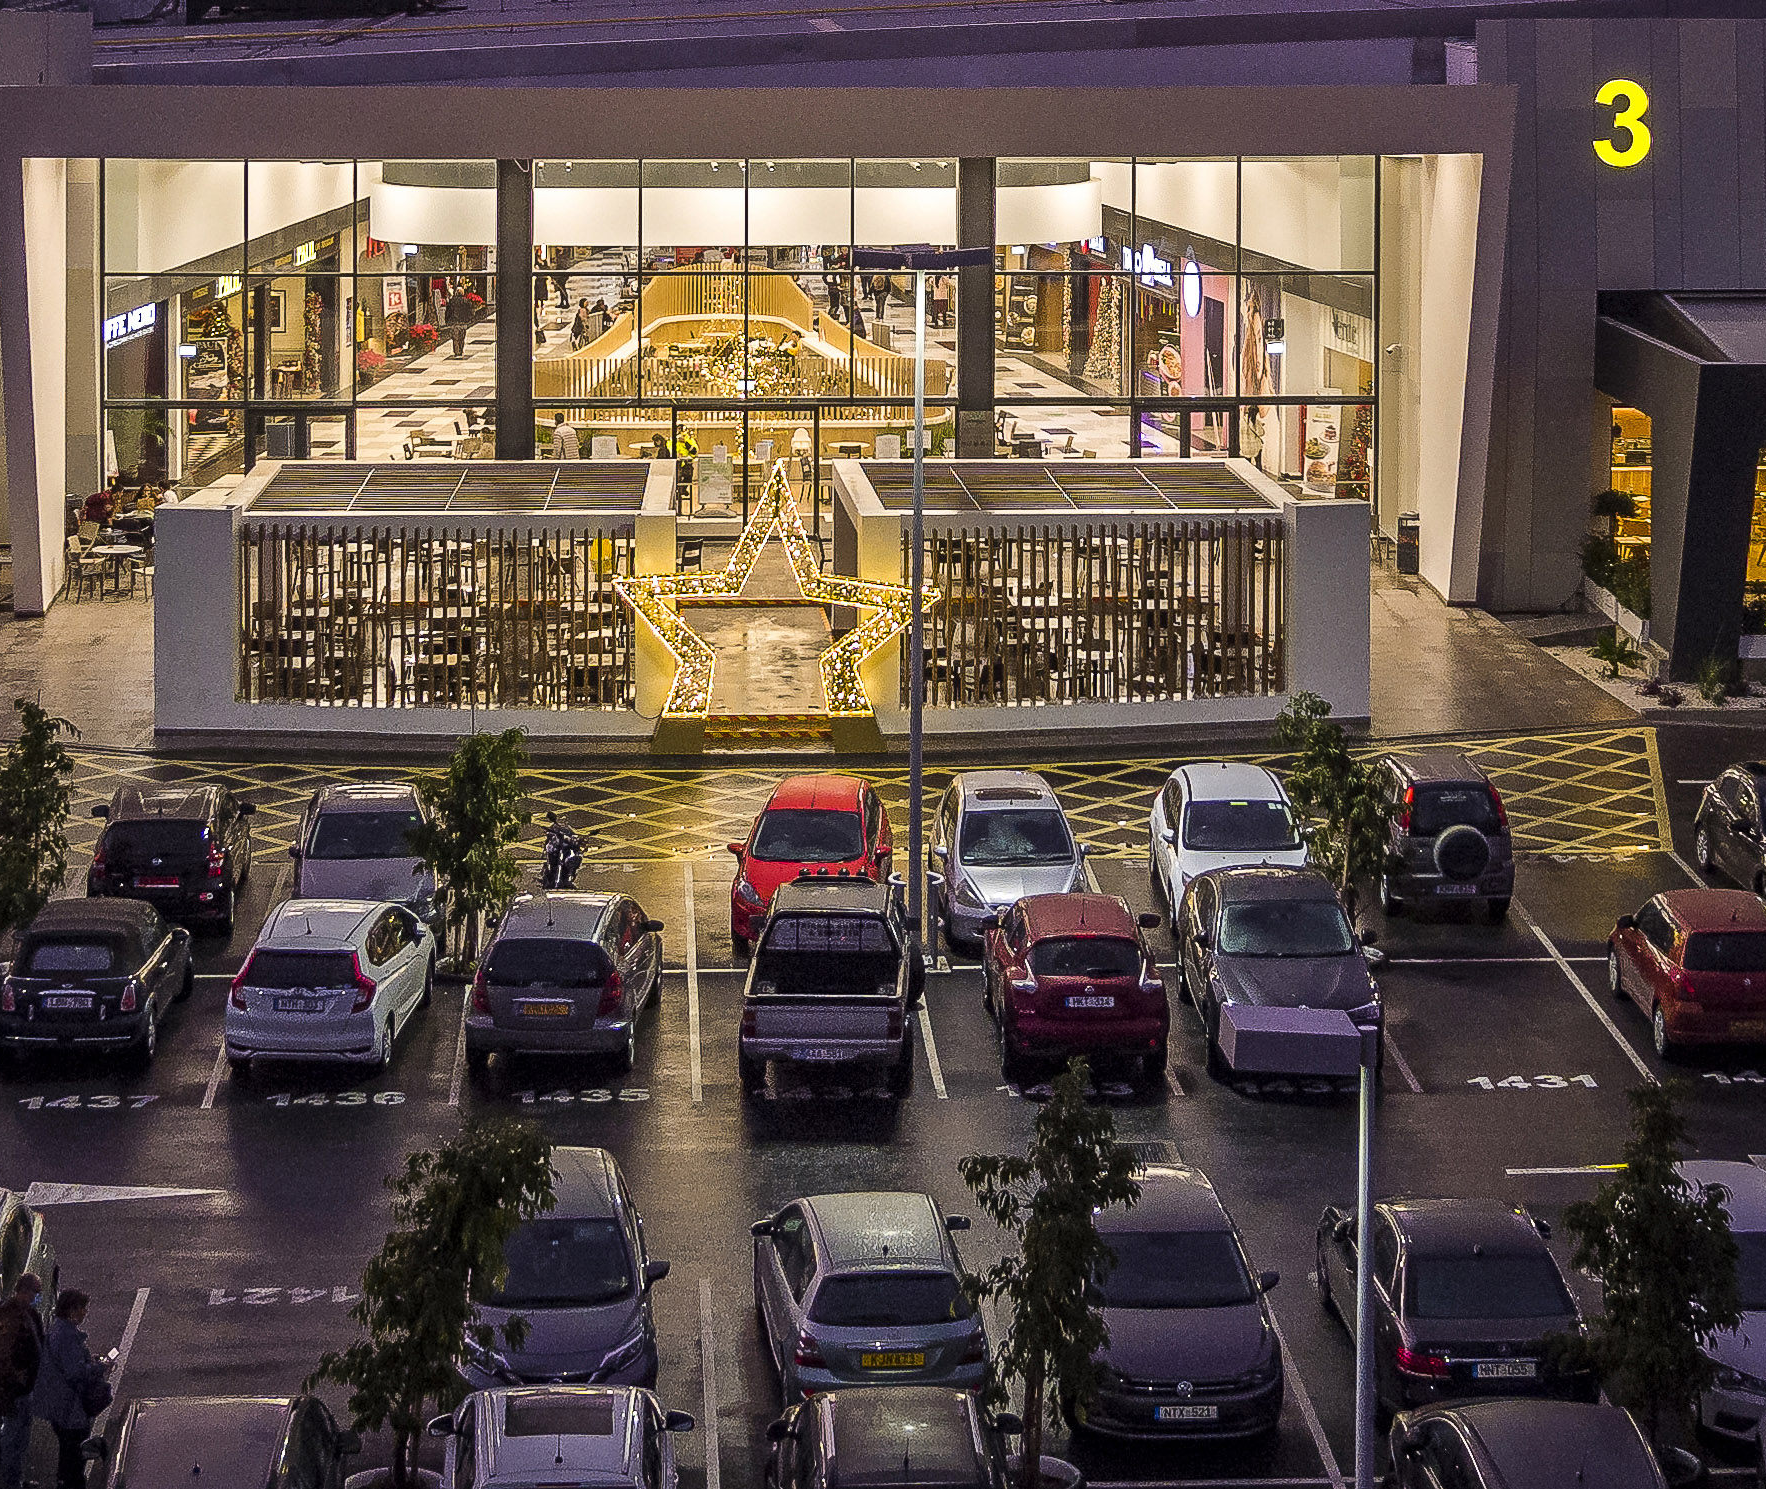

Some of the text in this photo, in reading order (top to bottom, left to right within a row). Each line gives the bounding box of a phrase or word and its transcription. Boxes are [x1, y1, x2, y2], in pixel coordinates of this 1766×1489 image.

[1591, 78, 1652, 168] 3
[295, 240, 317, 267] PAUL
[217, 269, 243, 300] PAUL
[1467, 1073, 1598, 1090] 1431
[19, 1095, 160, 1110] 1437
[266, 1092, 407, 1107] 1436
[510, 1088, 650, 1103] 1435
